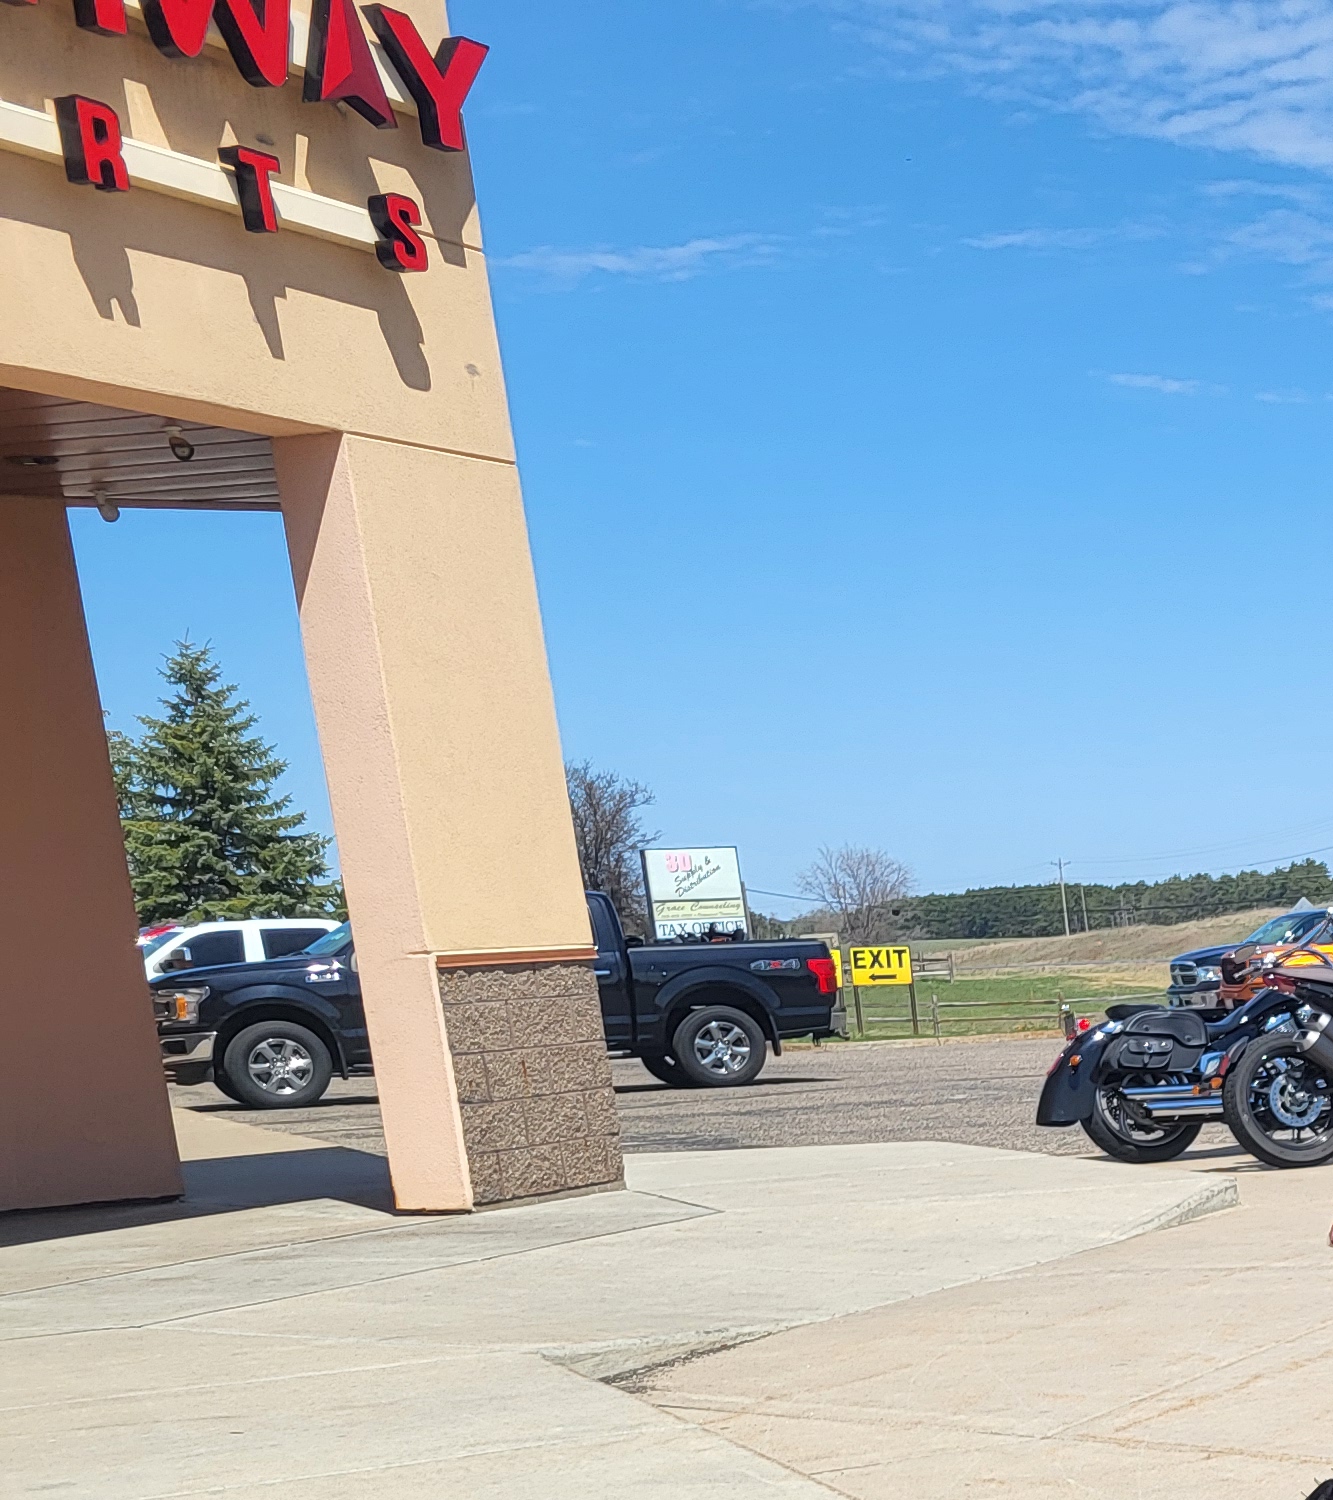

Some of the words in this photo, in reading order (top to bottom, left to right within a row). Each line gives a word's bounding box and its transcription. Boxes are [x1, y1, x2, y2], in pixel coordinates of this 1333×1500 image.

[658, 922, 687, 937] TAX
[691, 920, 744, 936] OFICE
[853, 949, 907, 970] EXIT
